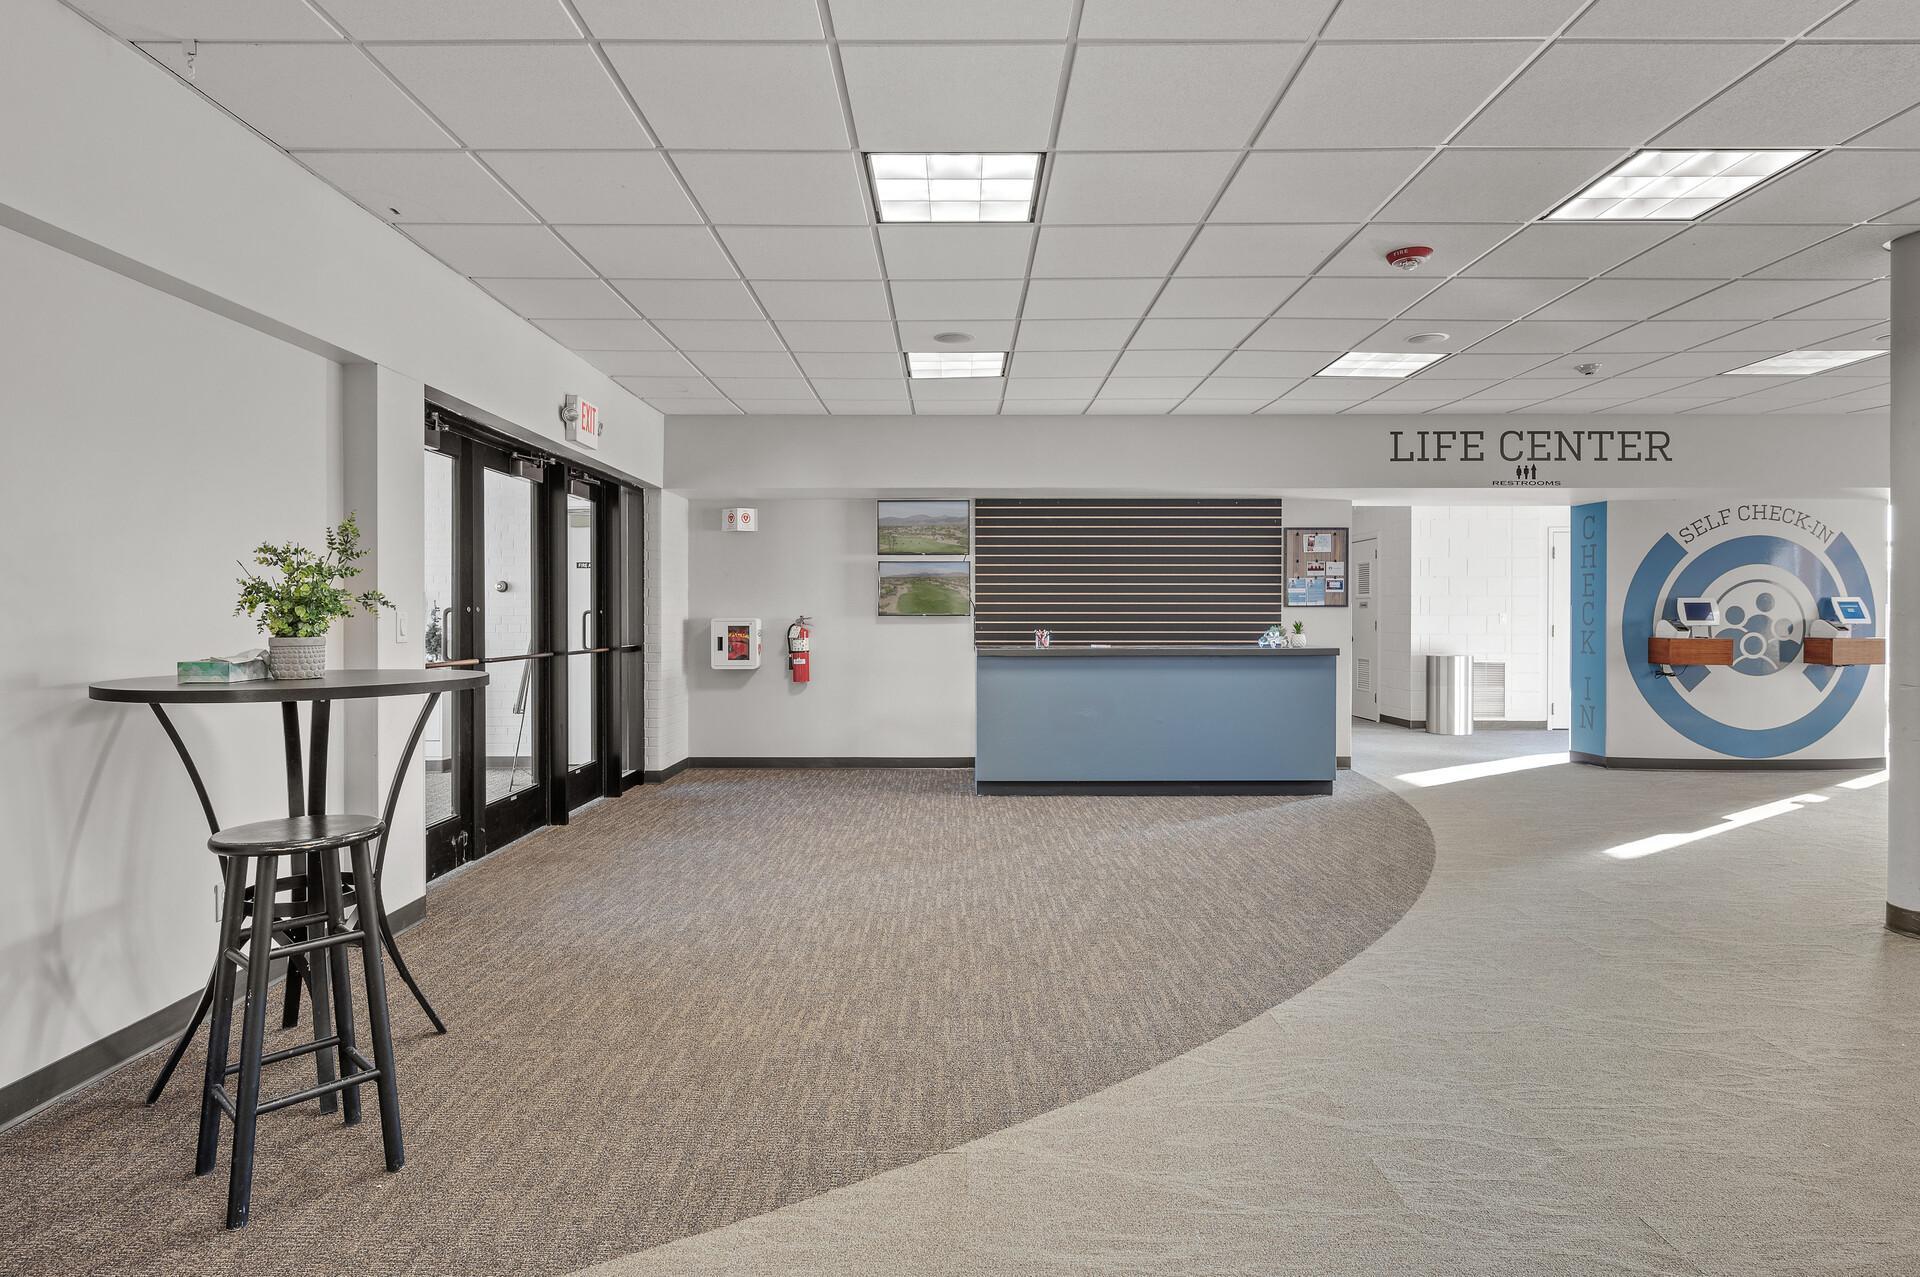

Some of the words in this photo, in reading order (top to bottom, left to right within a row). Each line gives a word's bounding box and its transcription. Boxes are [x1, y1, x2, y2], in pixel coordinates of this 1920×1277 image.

[1393, 248, 1409, 257] FIRE
[581, 401, 597, 436] EXIT
[1390, 431, 1484, 462] LIFE
[1500, 430, 1672, 462] CENTER
[1679, 508, 1731, 544] SELF
[1737, 504, 1834, 544] CHECK-IN
[1580, 515, 1597, 655] CHECK
[1580, 676, 1596, 730] IN
